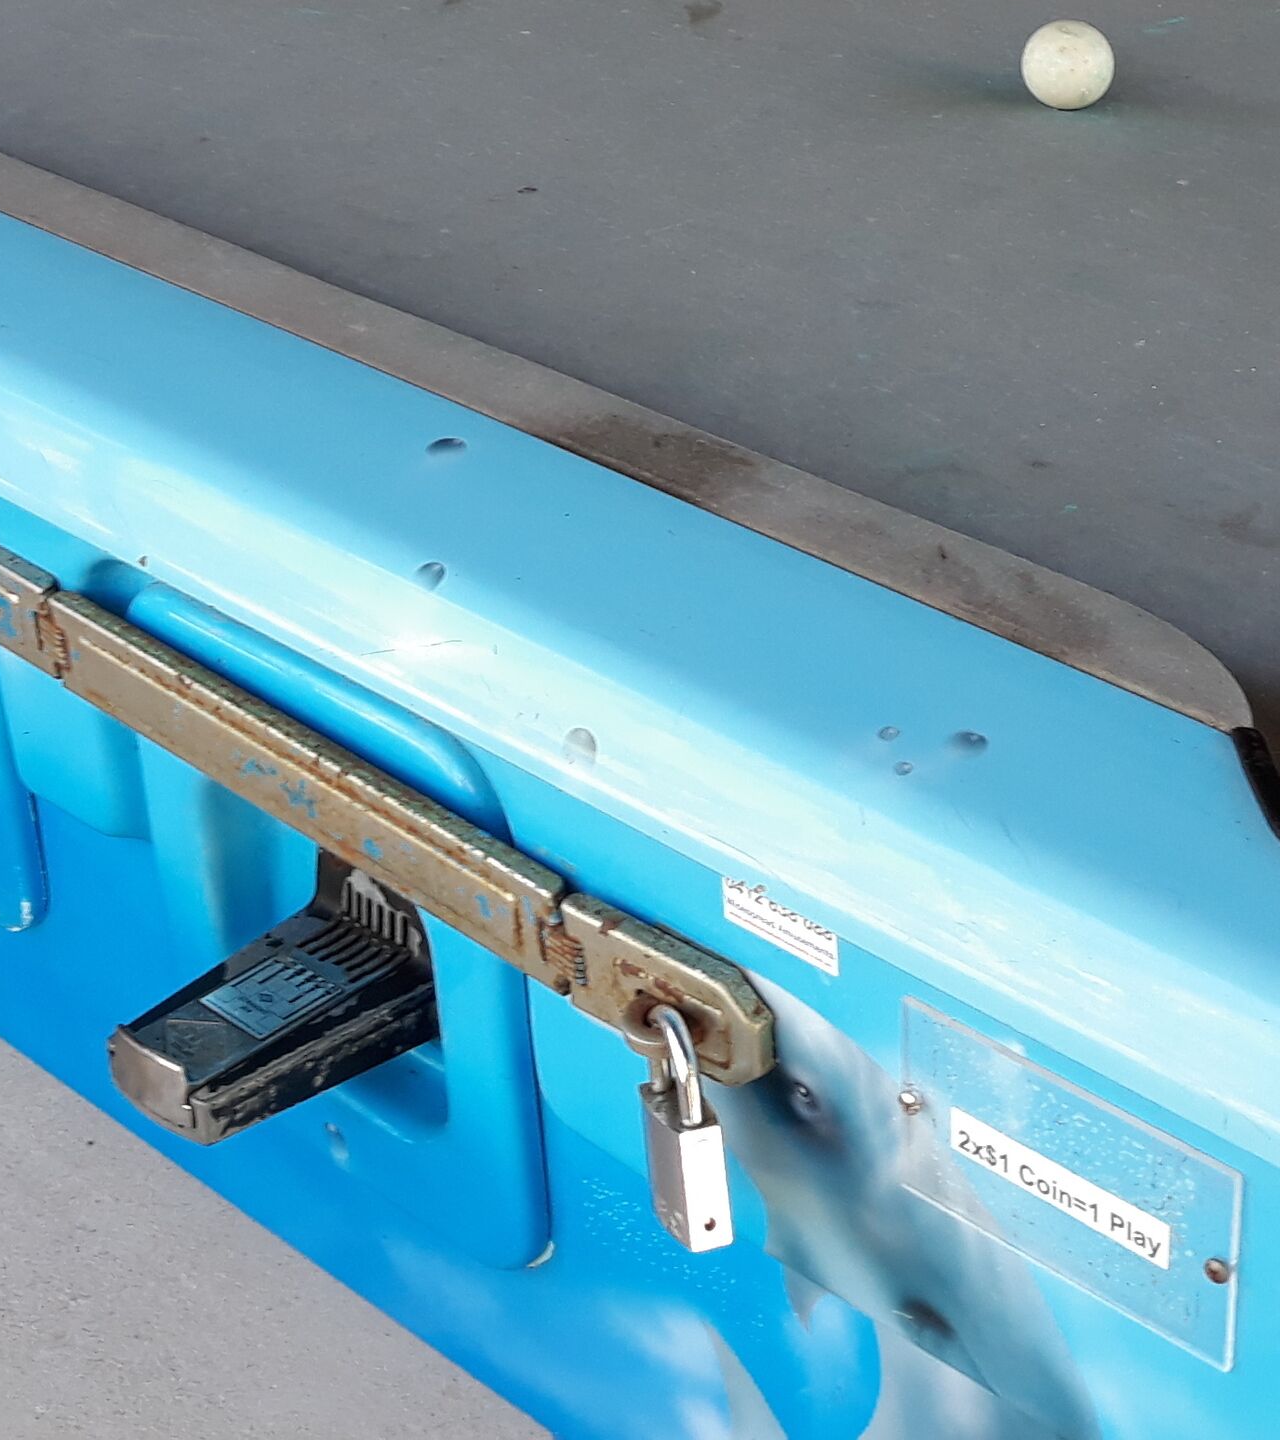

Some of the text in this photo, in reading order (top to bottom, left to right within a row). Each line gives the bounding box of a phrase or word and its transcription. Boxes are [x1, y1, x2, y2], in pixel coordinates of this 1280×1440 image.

[958, 1130, 1162, 1258] 2x$1 Coin=1 Play
